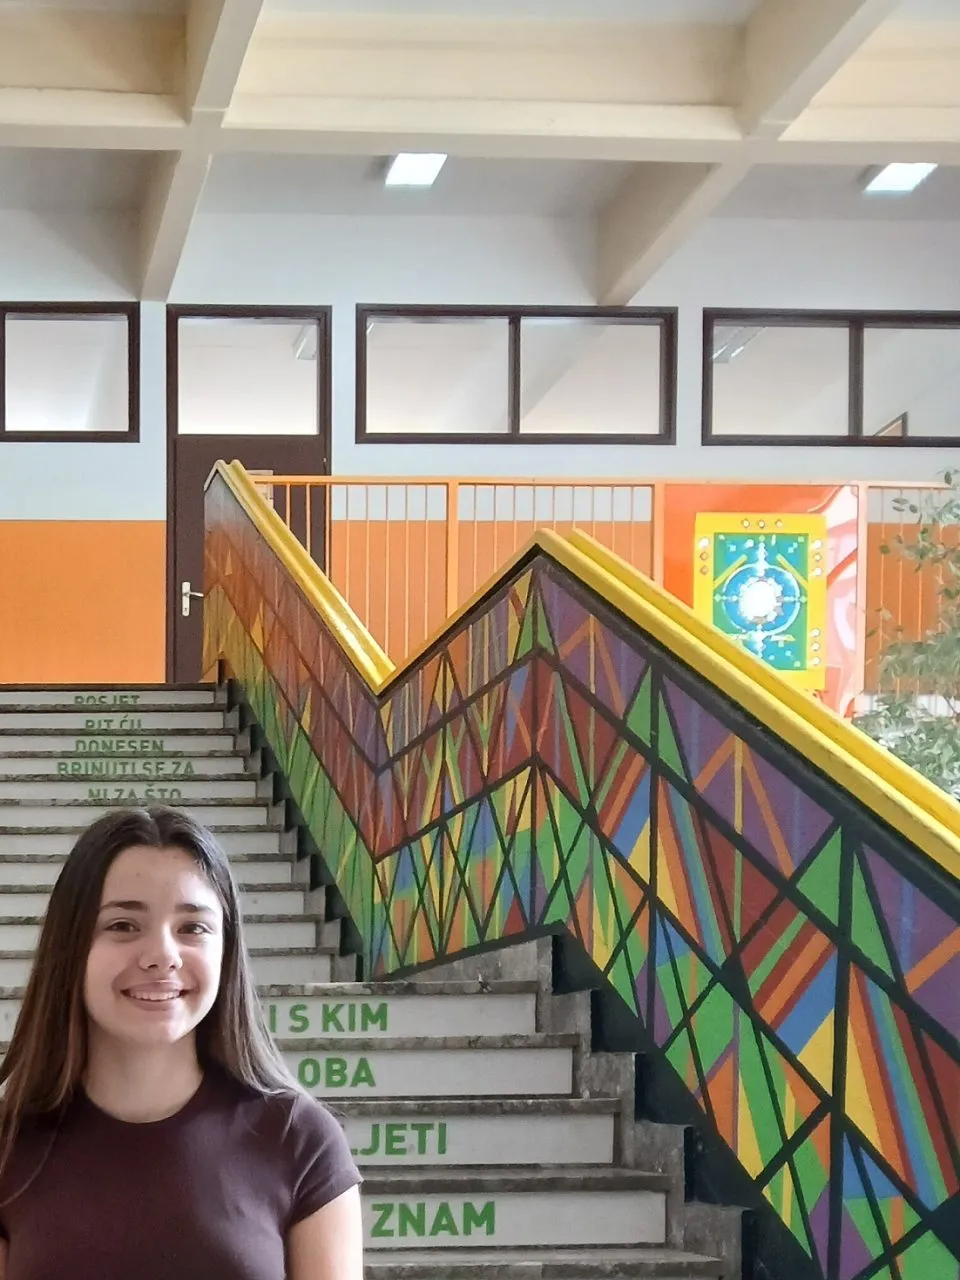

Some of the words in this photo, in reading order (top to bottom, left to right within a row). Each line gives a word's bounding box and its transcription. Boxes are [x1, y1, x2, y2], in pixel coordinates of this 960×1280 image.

[288, 1003, 310, 1033] S
[321, 1002, 389, 1033] KIM
[297, 1056, 376, 1088] OBA
[341, 1123, 448, 1156] JETI
[370, 1201, 496, 1238] ZNAM
